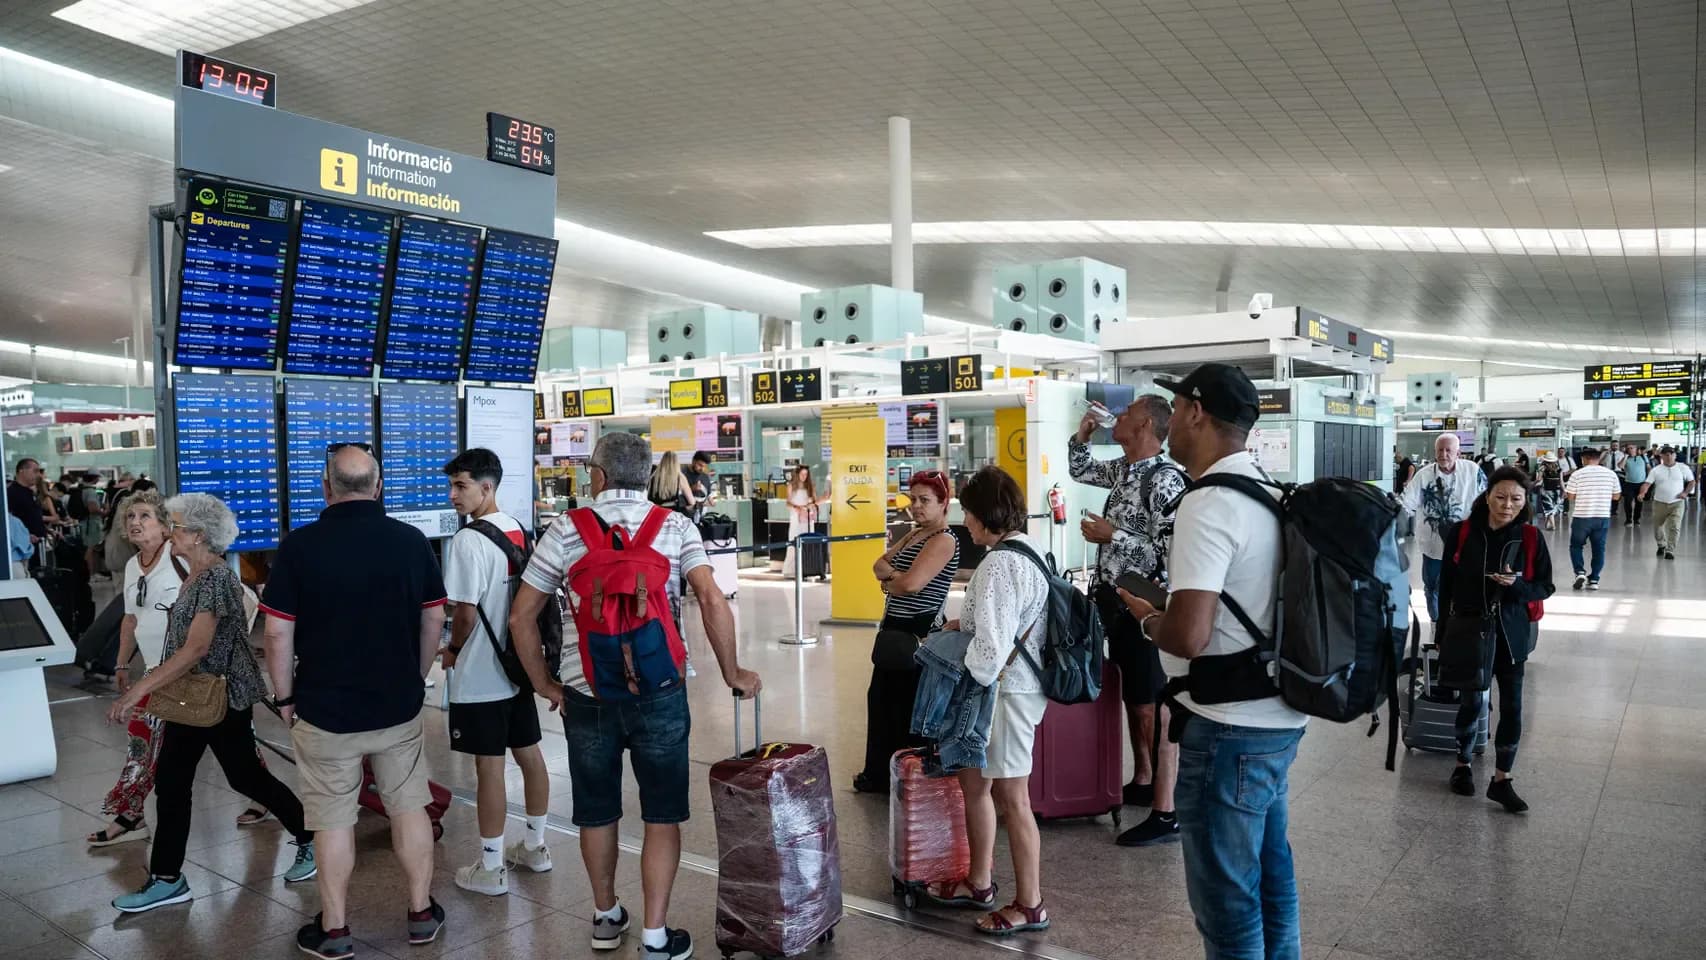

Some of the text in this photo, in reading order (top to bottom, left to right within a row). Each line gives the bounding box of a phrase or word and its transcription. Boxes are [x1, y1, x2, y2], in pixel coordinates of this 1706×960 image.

[508, 120, 542, 144] 23.5
[367, 138, 453, 174] Informació
[521, 146, 542, 166] 54
[367, 159, 437, 189] Information
[366, 178, 461, 214] Información
[207, 217, 250, 230] Departures
[954, 377, 979, 390] 501
[473, 395, 497, 409] Mpox
[706, 395, 727, 406] 503
[755, 391, 776, 403] 502
[564, 406, 581, 418] 504
[849, 464, 868, 473] EXIT
